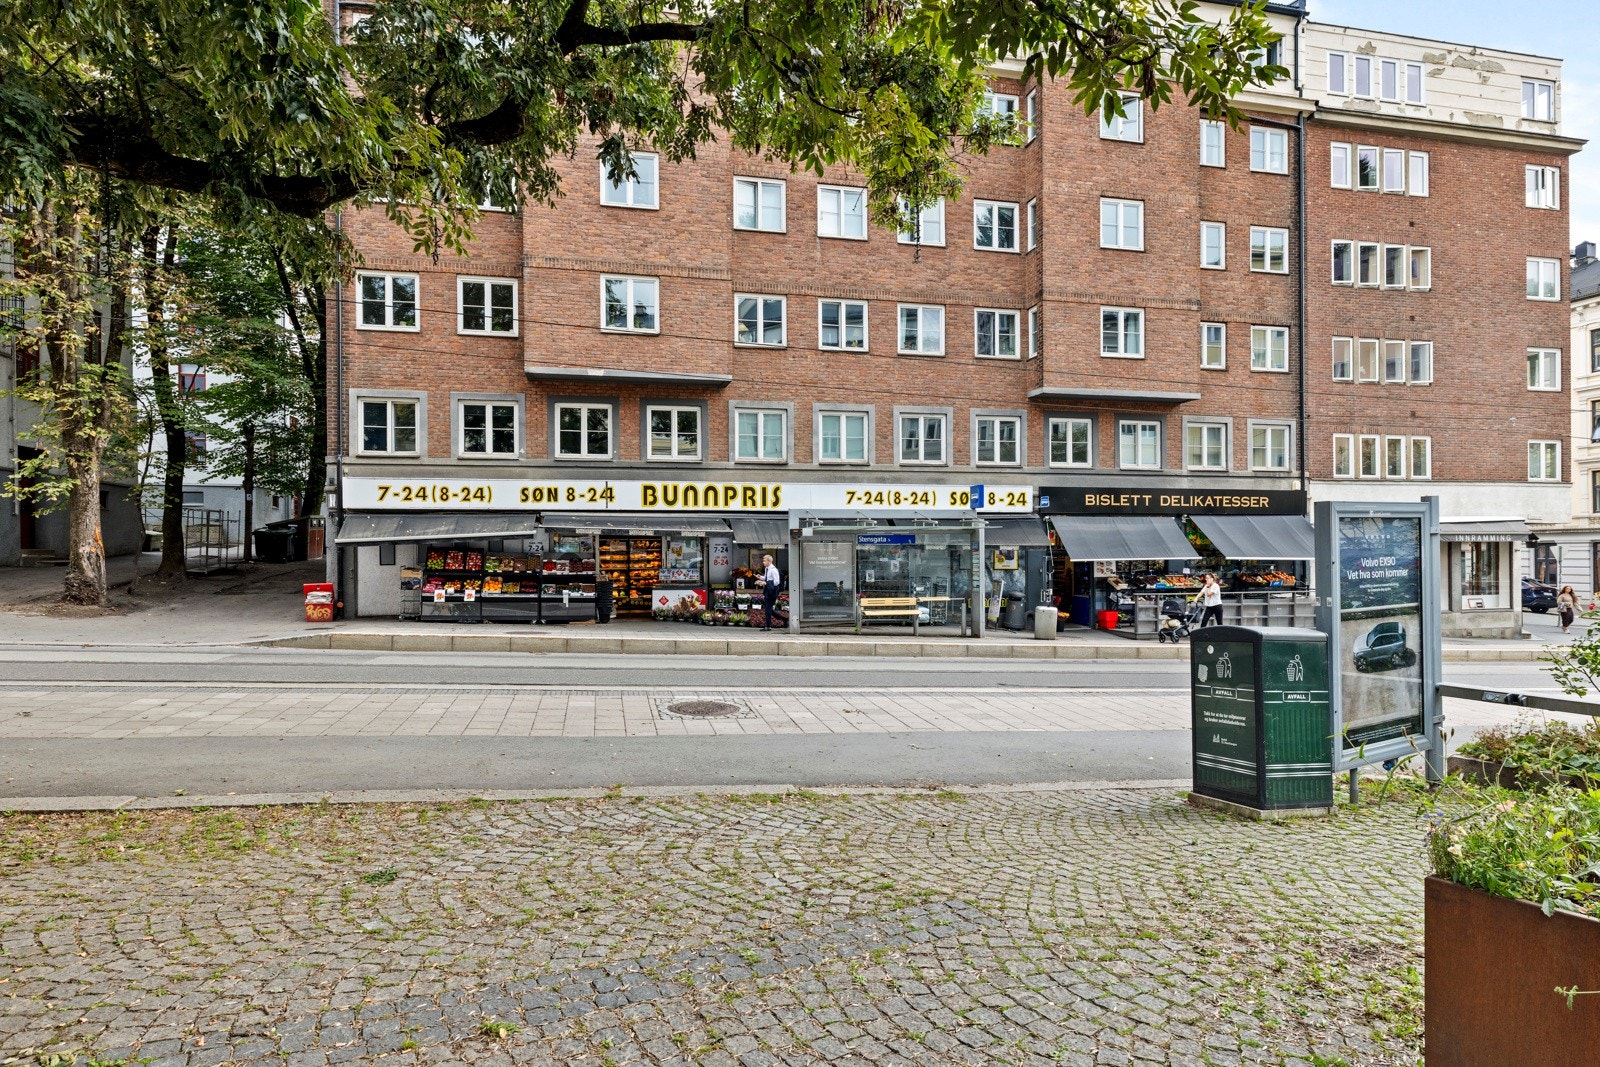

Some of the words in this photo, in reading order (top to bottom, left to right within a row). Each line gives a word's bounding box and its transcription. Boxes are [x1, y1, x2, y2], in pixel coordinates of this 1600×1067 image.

[377, 485, 493, 504] 7-24(8-24)
[520, 486, 559, 503] SØN
[565, 486, 616, 503] 8-24
[641, 483, 782, 509] BUNNPRIS
[845, 490, 937, 507] 7-24(8-24)
[949, 491, 970, 506] SØ
[988, 492, 1028, 506] 8-24
[1085, 494, 1152, 506] BISLETT
[1160, 495, 1270, 508] DELIKATESSER
[858, 536, 887, 544] Stensgata
[1361, 557, 1379, 567] Volvo
[1380, 556, 1396, 566] EX90
[1347, 570, 1359, 580] Vet
[1360, 569, 1371, 579] hva
[1371, 569, 1385, 578] som
[1386, 568, 1409, 578] kommer
